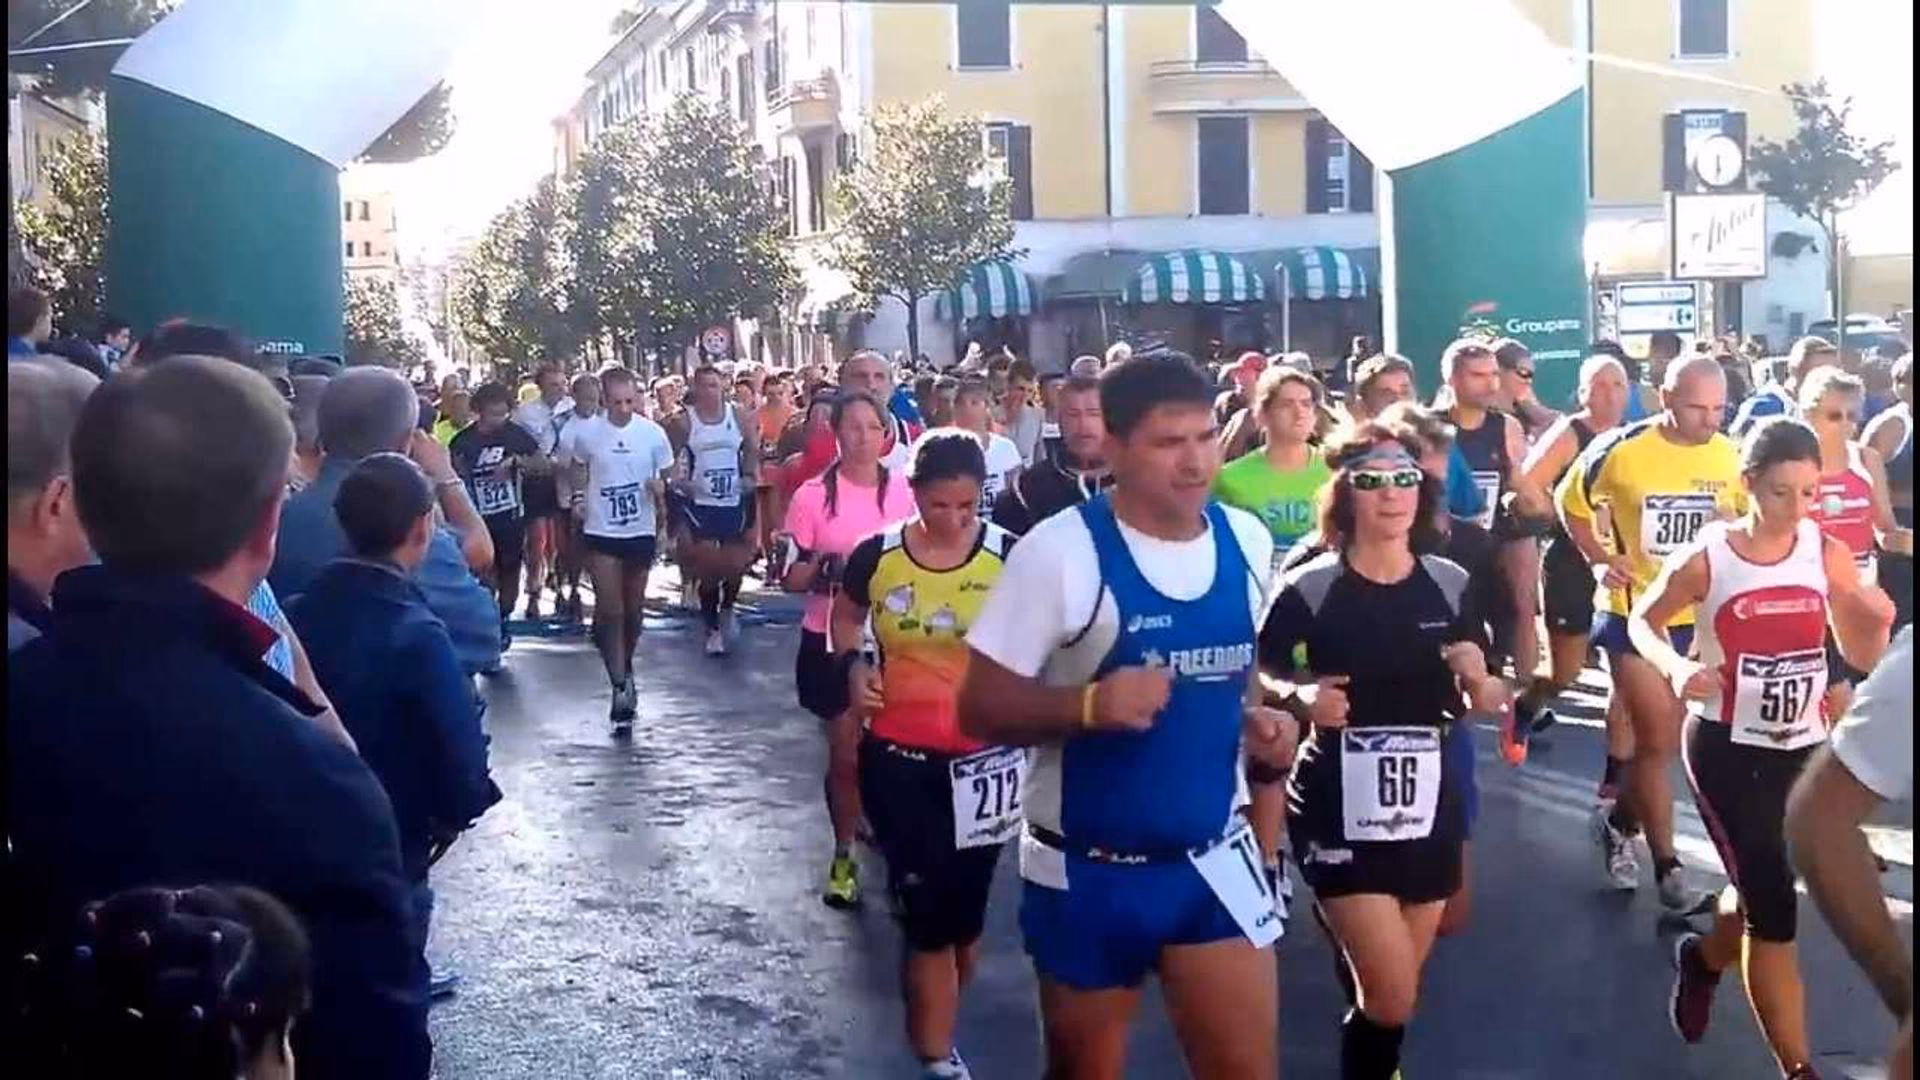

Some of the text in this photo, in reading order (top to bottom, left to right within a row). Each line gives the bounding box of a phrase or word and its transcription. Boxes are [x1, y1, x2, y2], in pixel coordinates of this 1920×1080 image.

[1760, 676, 1814, 724] 567
[972, 767, 1020, 821] 272
[1377, 755, 1418, 808] 66
